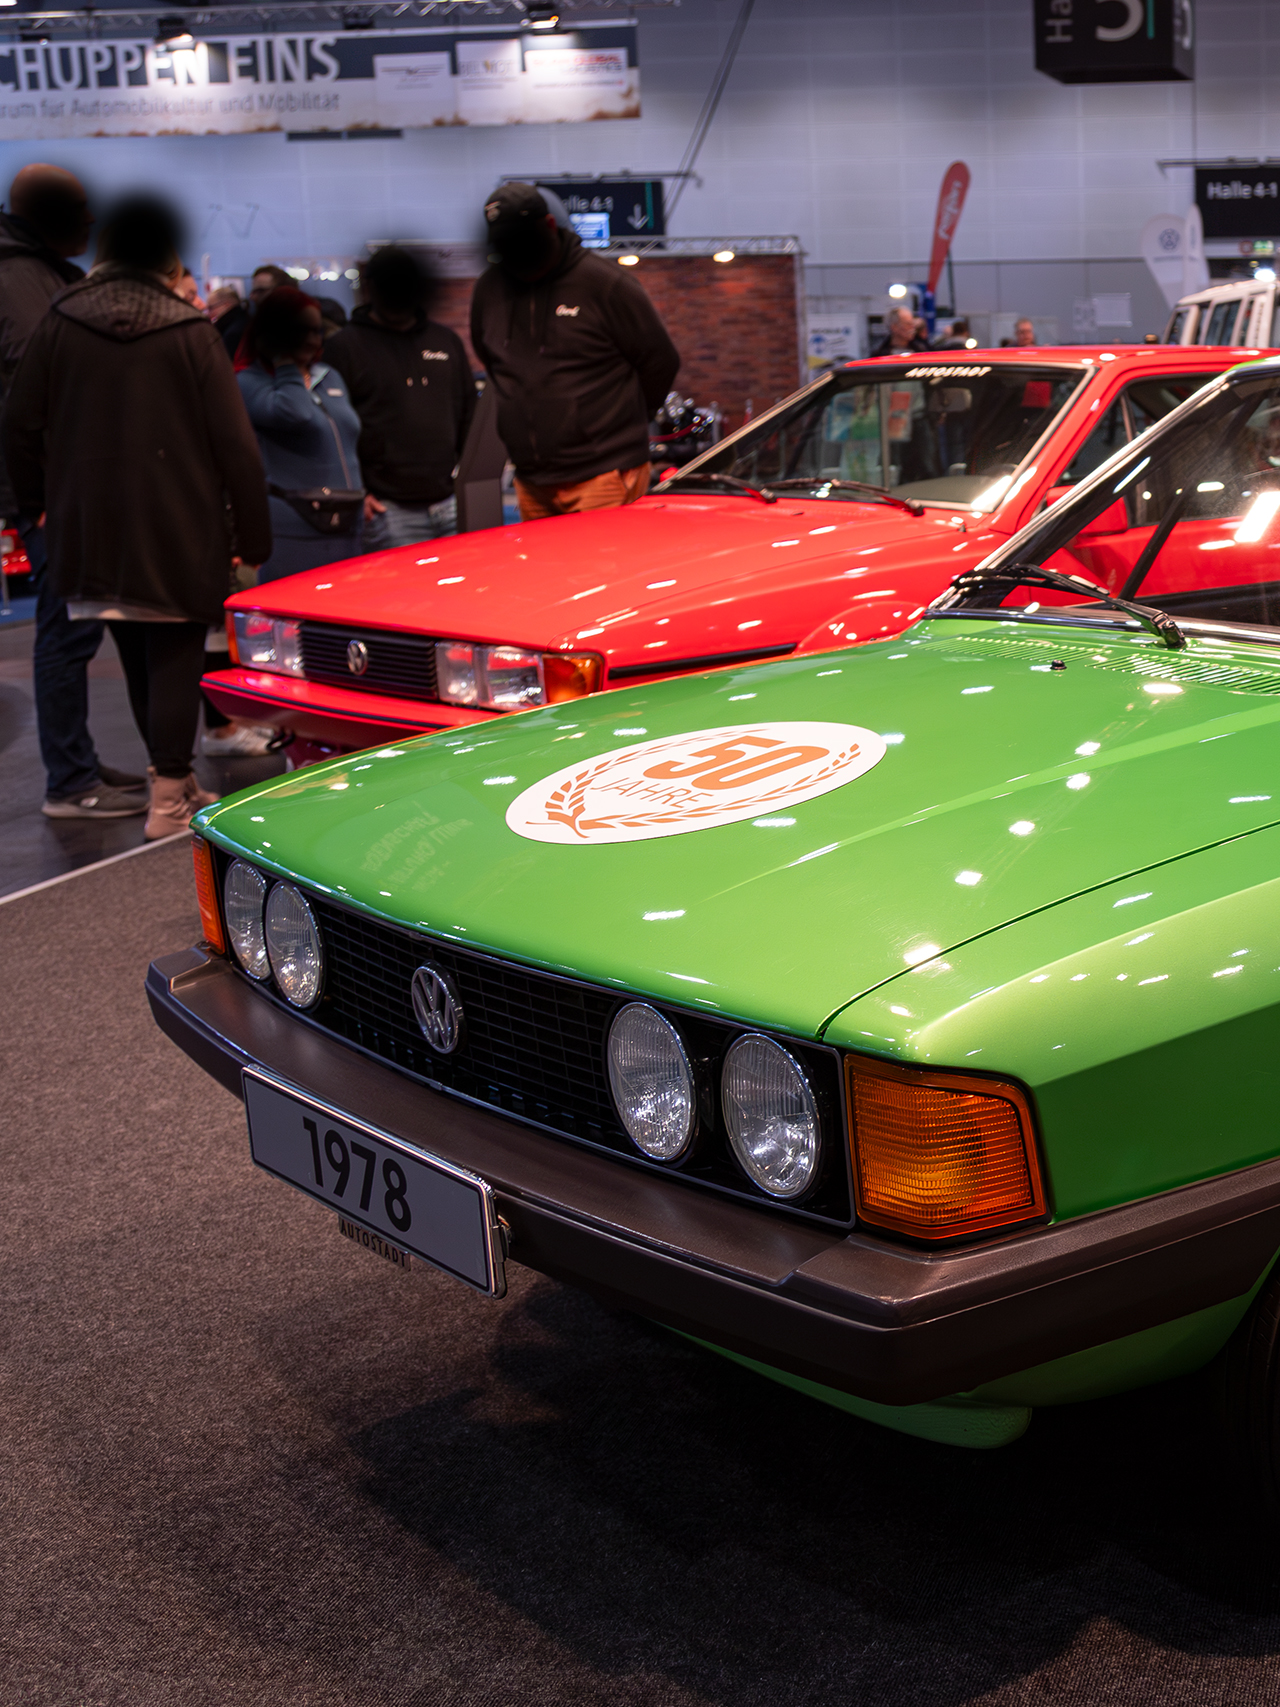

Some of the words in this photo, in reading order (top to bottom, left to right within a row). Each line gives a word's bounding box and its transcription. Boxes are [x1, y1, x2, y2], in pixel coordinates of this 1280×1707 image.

[229, 37, 340, 82] EINS
[1207, 180, 1252, 200] Halle
[1253, 181, 1278, 199] 4-1
[905, 366, 992, 379] AUTOSTADT
[643, 735, 830, 790] 50
[592, 776, 714, 808] JAHRE
[303, 1116, 412, 1233] 1978
[340, 1219, 407, 1268] AUTOSTADT
